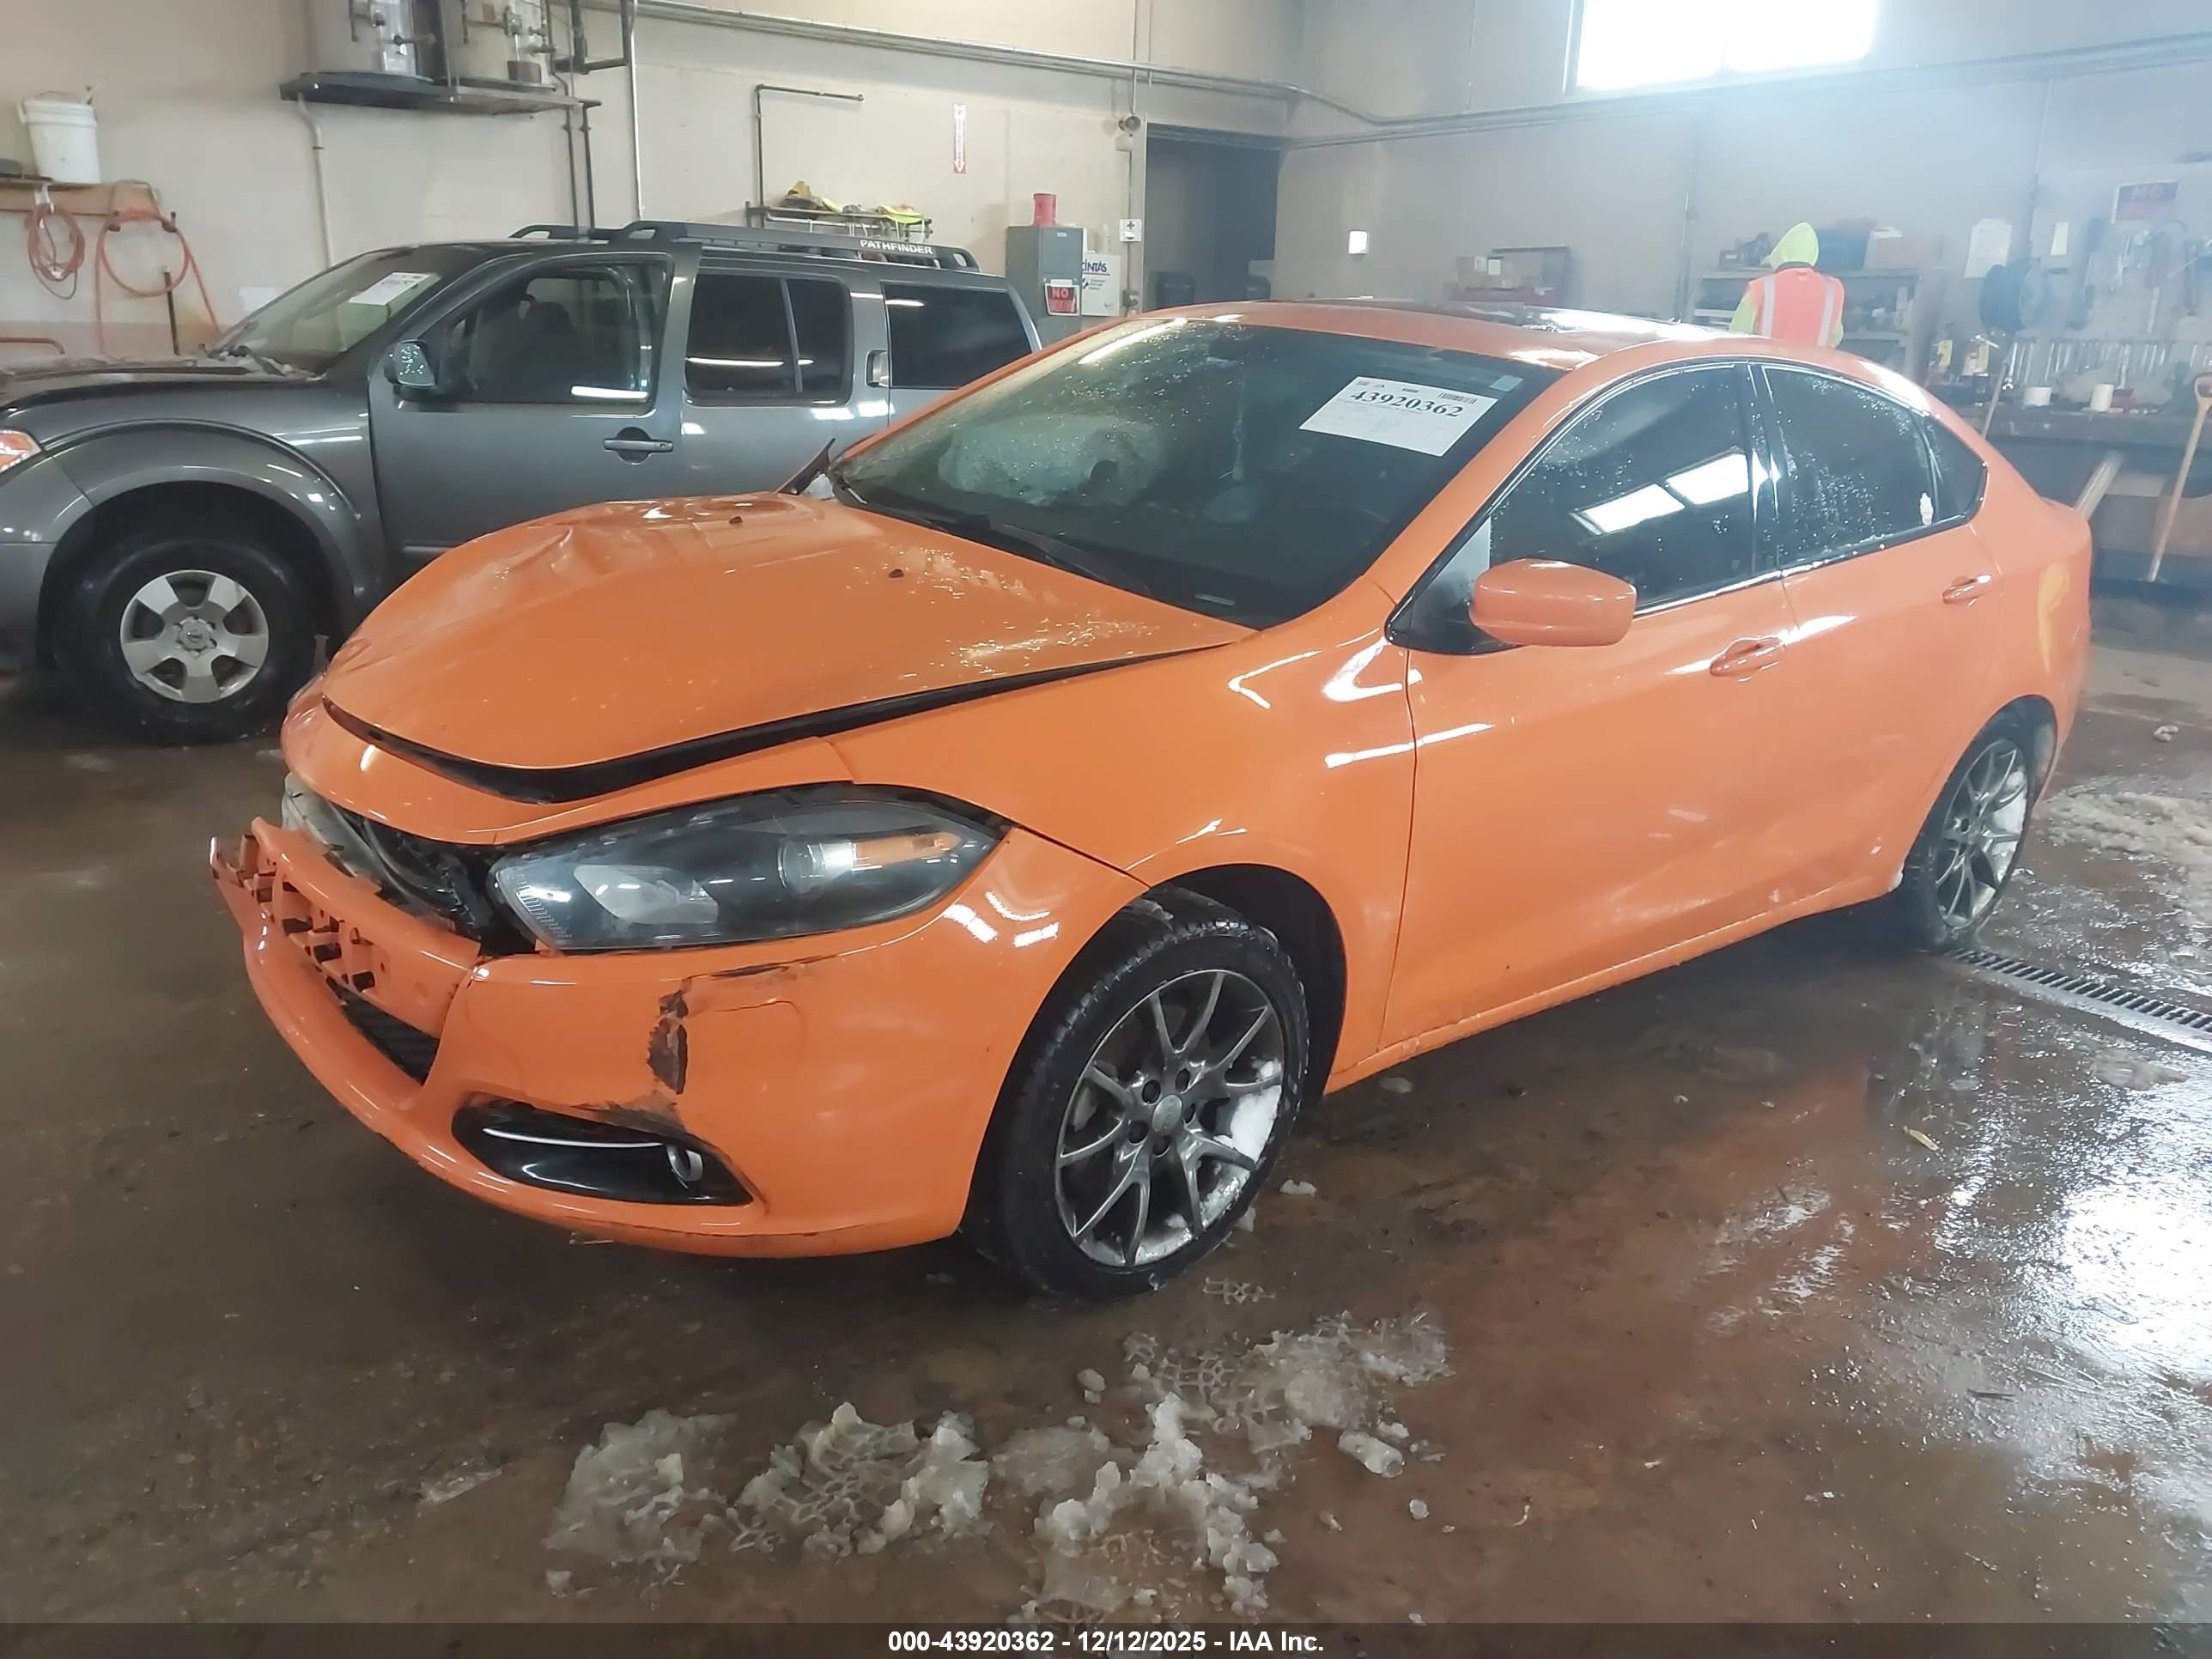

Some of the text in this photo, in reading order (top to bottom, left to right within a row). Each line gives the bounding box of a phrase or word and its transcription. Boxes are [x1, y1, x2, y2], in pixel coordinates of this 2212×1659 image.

[860, 240, 933, 255] PATHFINDER
[1051, 288, 1070, 299] NO
[1350, 391, 1464, 418] 43920362
